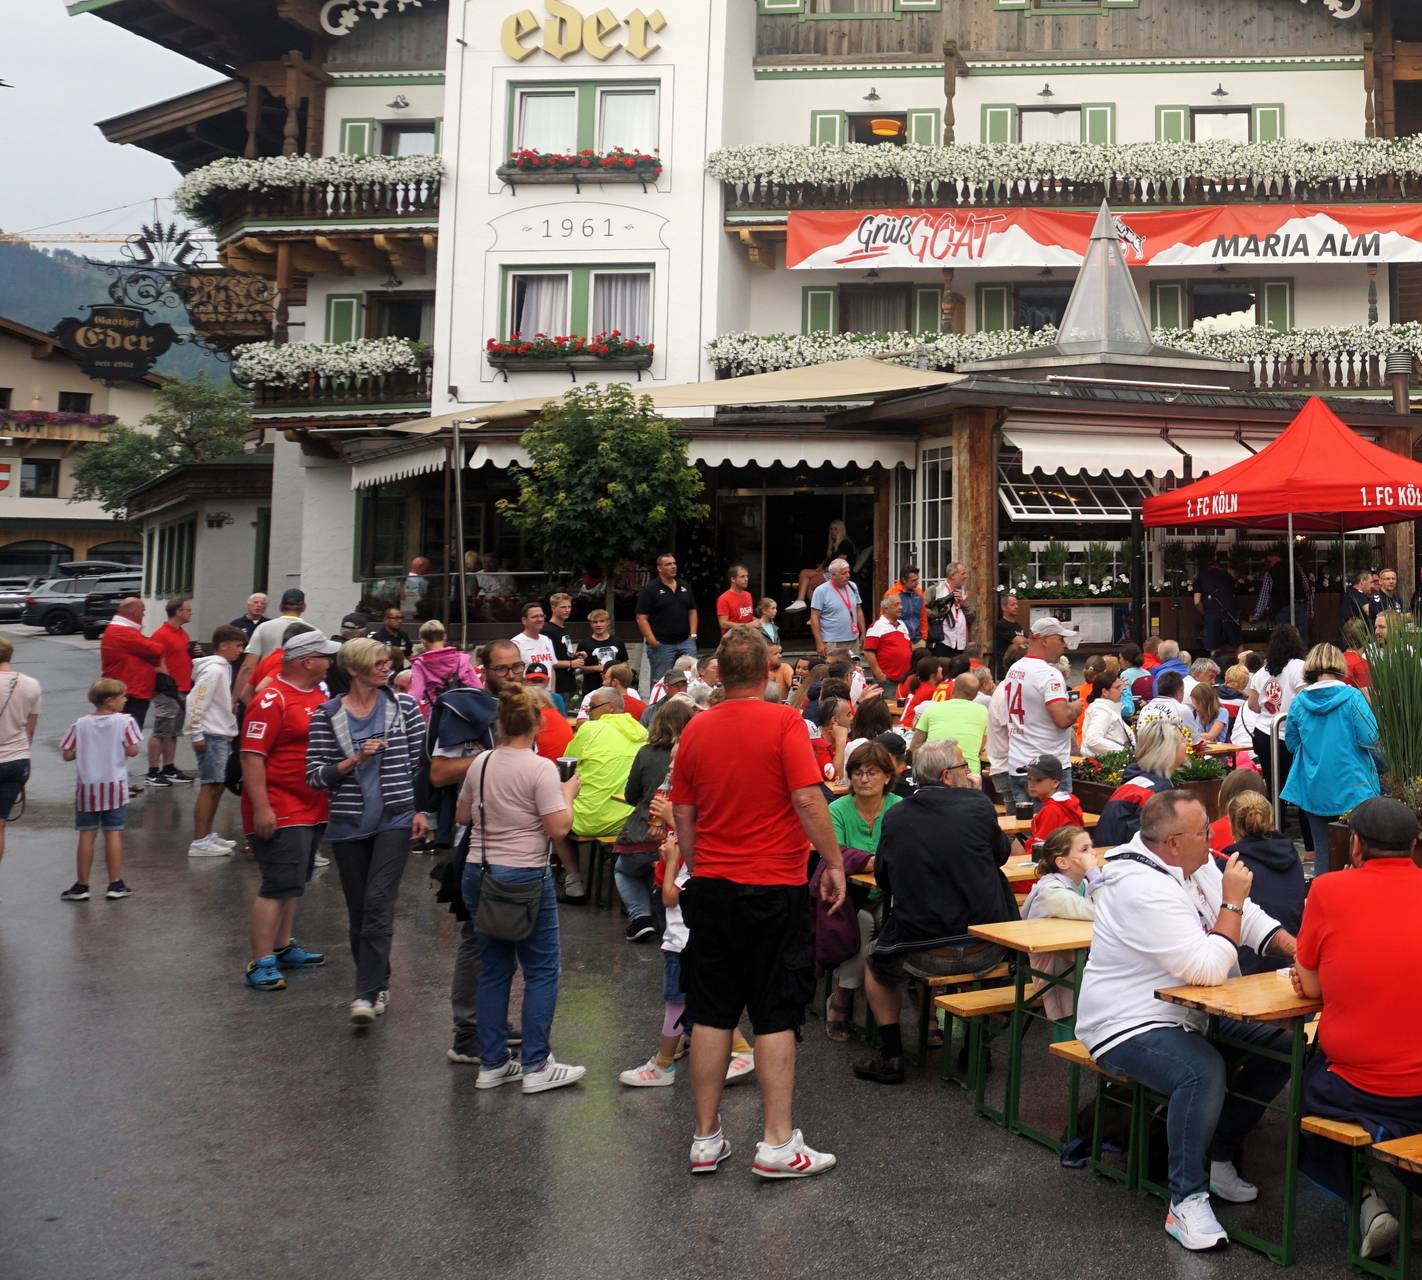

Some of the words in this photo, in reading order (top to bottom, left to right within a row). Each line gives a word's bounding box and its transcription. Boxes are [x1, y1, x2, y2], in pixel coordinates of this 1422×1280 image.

[501, 0, 667, 62] eder
[541, 218, 614, 238] 1961
[857, 215, 913, 252] Grüß
[1211, 233, 1310, 258] MARIA
[1316, 232, 1381, 257] ALM
[74, 326, 155, 352] Eder
[1196, 497, 1210, 517] FC
[1212, 490, 1238, 514] KÖLN
[1360, 486, 1372, 507] 1.
[1376, 486, 1394, 506] FC
[1005, 682, 1025, 725] 14
